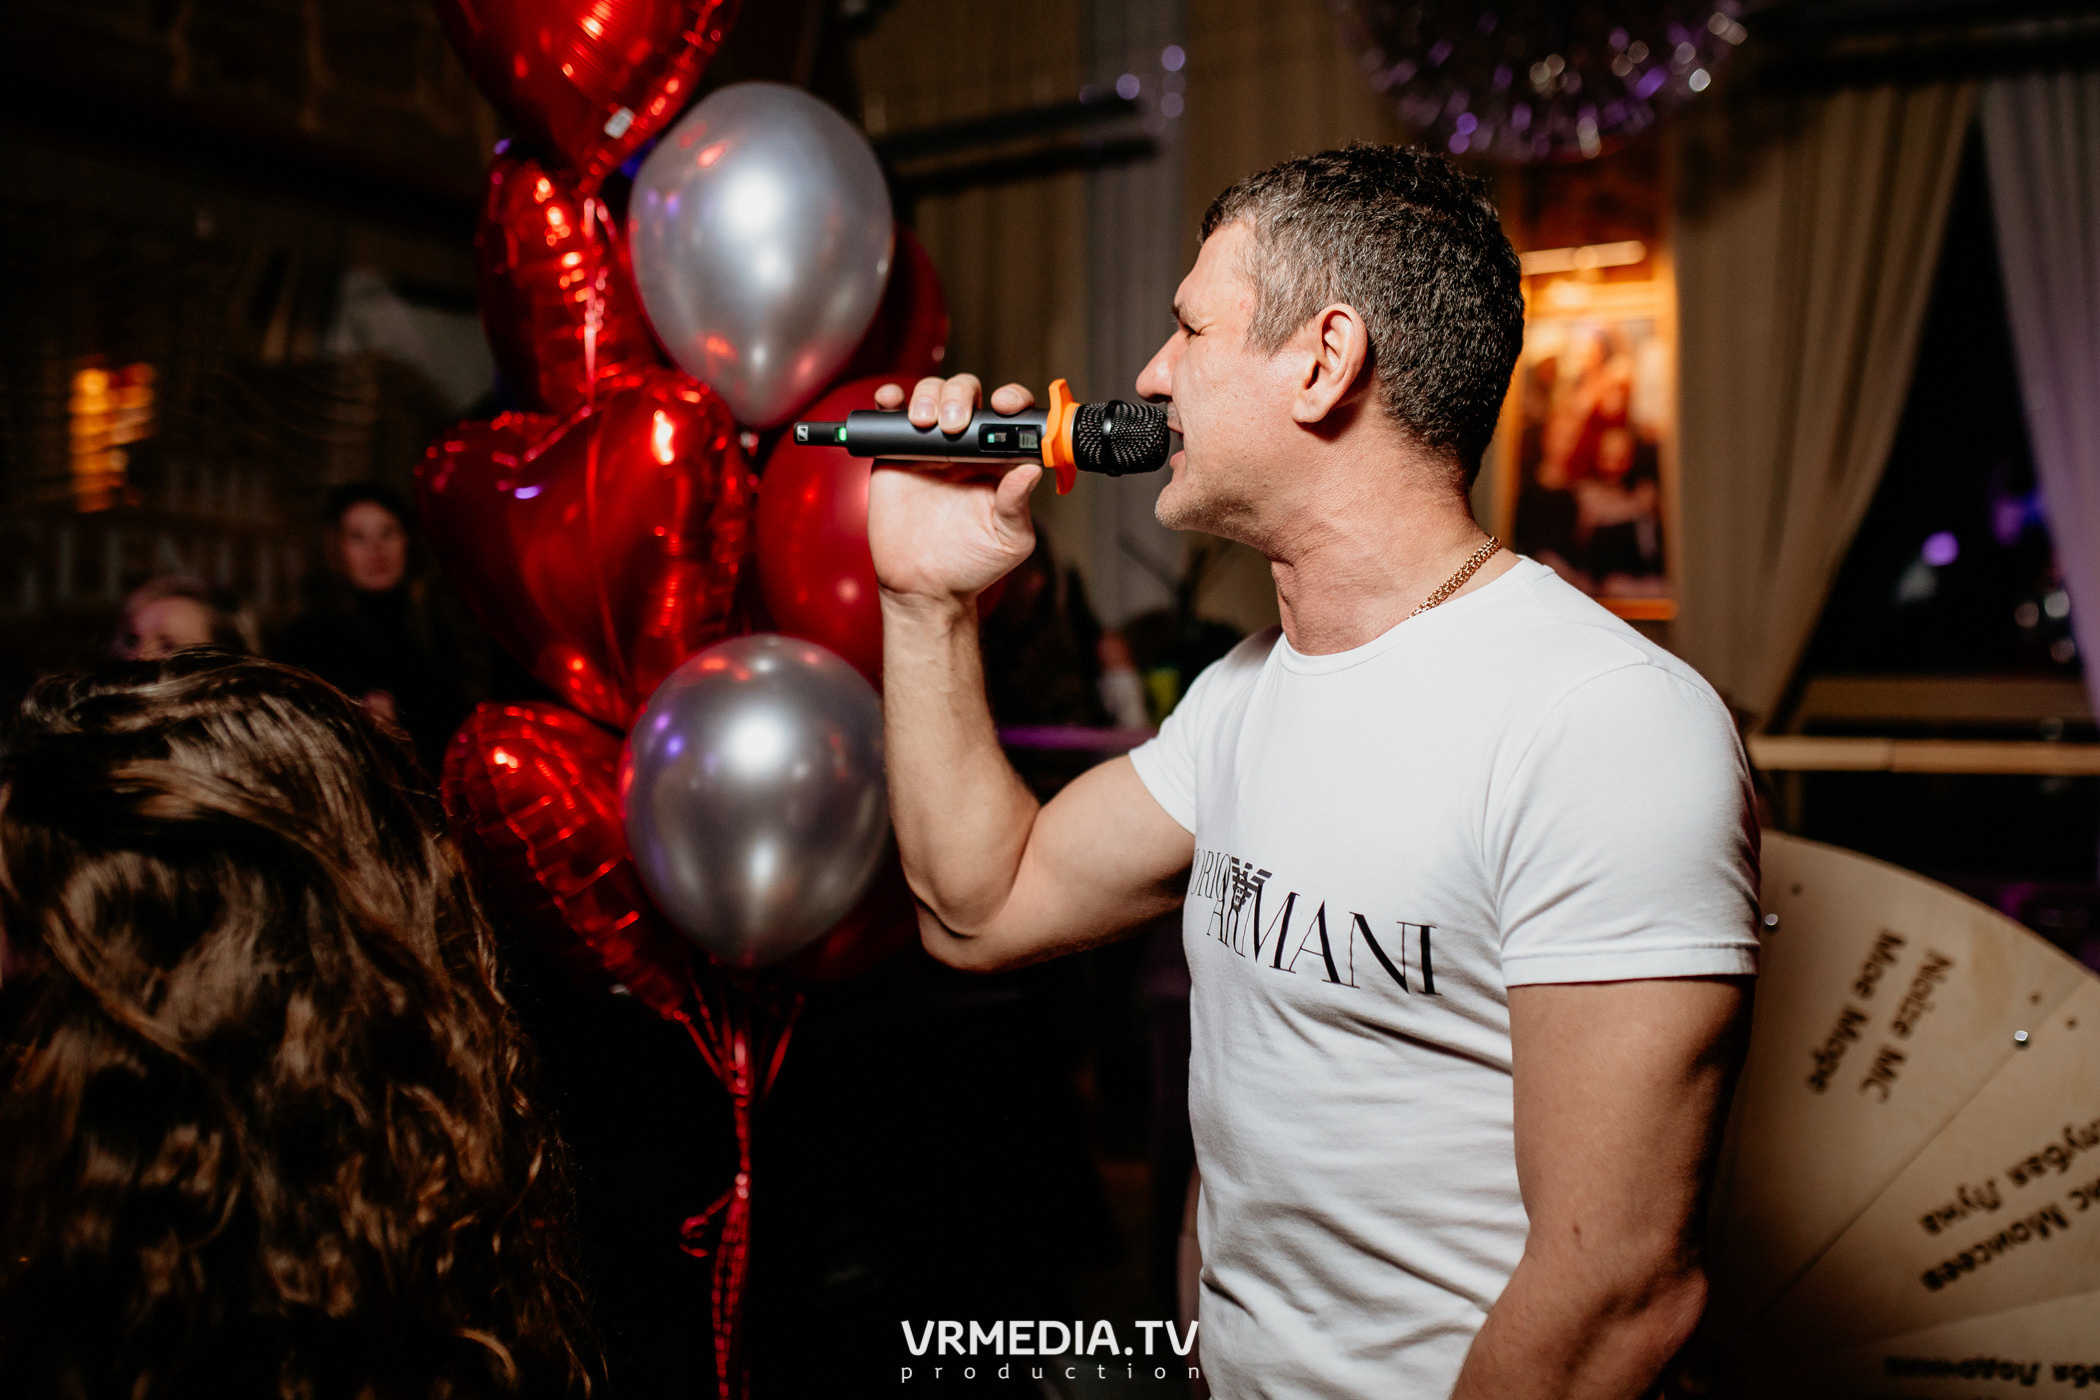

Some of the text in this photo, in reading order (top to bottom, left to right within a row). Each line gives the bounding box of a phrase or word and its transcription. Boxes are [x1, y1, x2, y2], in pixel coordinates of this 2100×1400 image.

[1207, 865, 1442, 996] ARMANI
[1809, 1005, 1868, 1092] Море
[1859, 948, 1954, 1102] Noize MC
[1920, 1178, 2000, 1233] Луна
[1922, 1204, 2069, 1290] Моисеев
